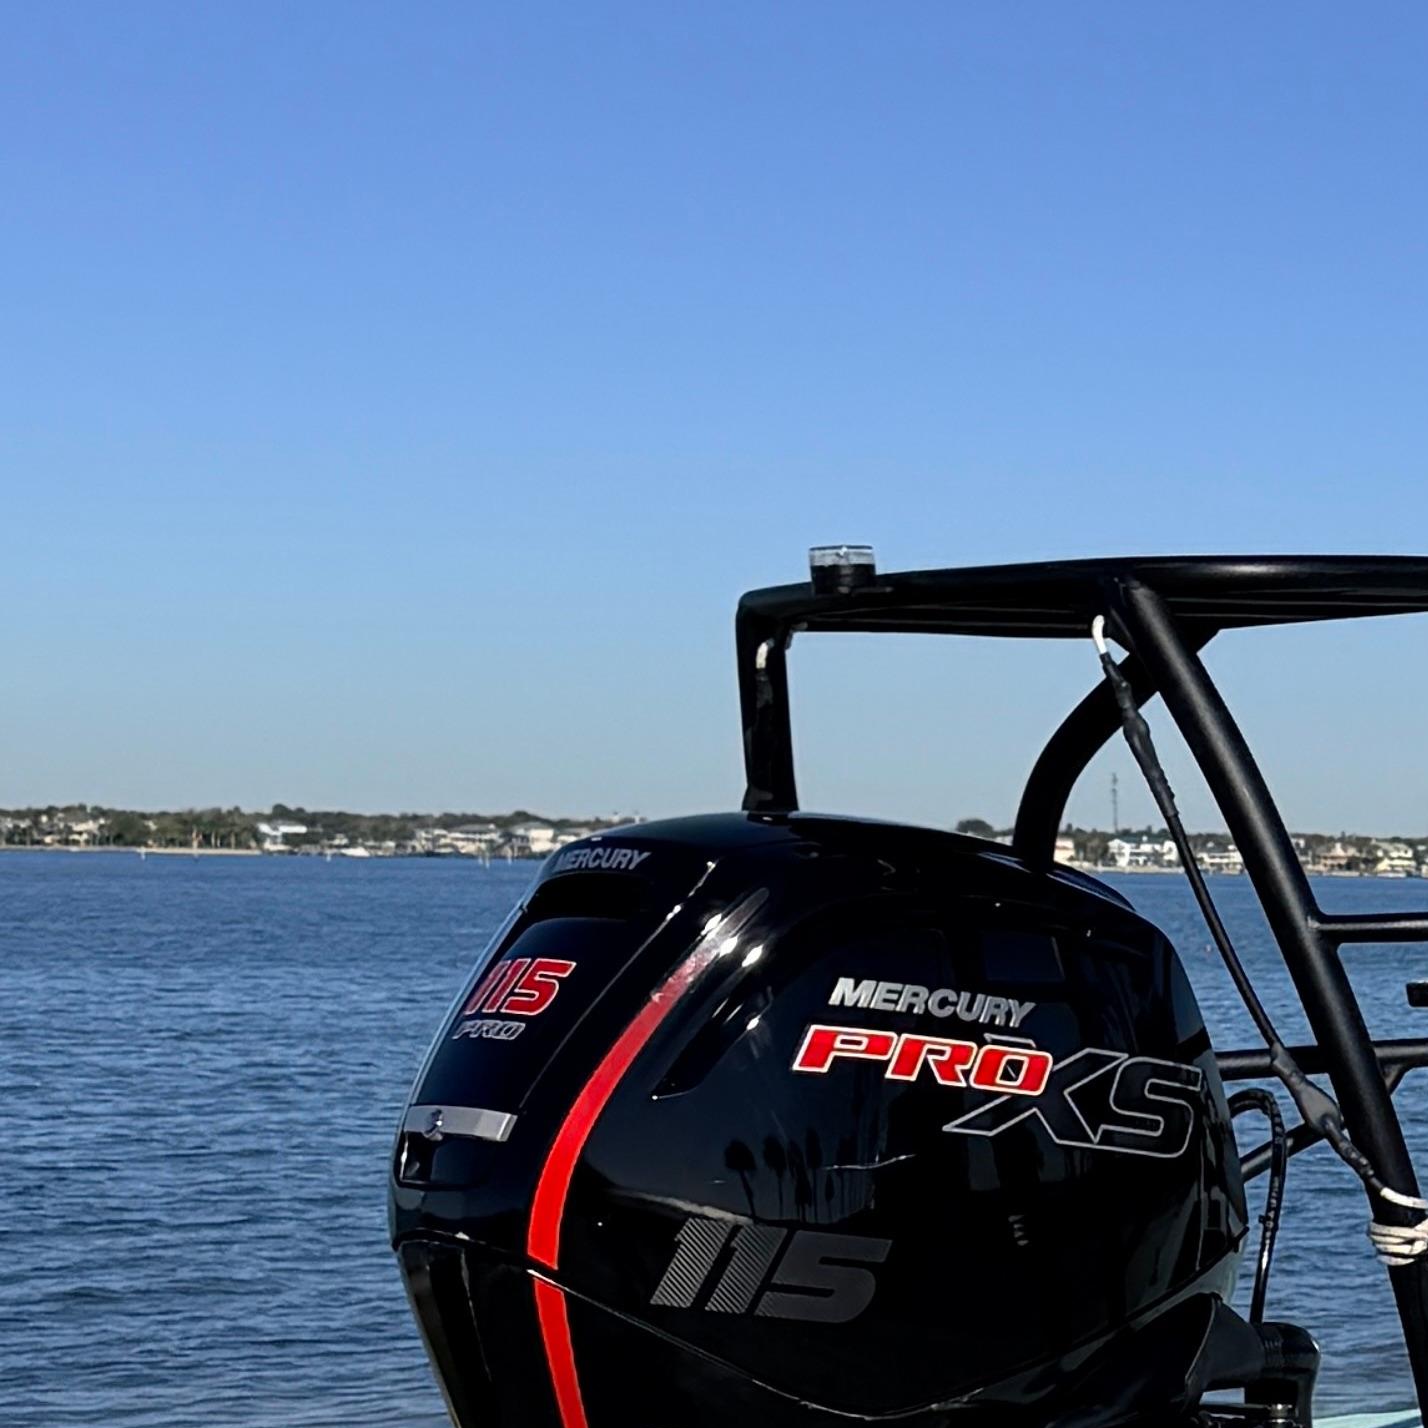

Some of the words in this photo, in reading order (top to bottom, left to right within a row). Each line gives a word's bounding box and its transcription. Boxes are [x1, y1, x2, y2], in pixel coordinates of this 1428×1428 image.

[554, 848, 652, 871] MERCURY
[464, 957, 577, 1016] 115
[828, 977, 1036, 1028] MERCURY
[451, 1019, 526, 1041] PRO
[791, 1024, 1053, 1096] PRO
[650, 1219, 893, 1325] 115
